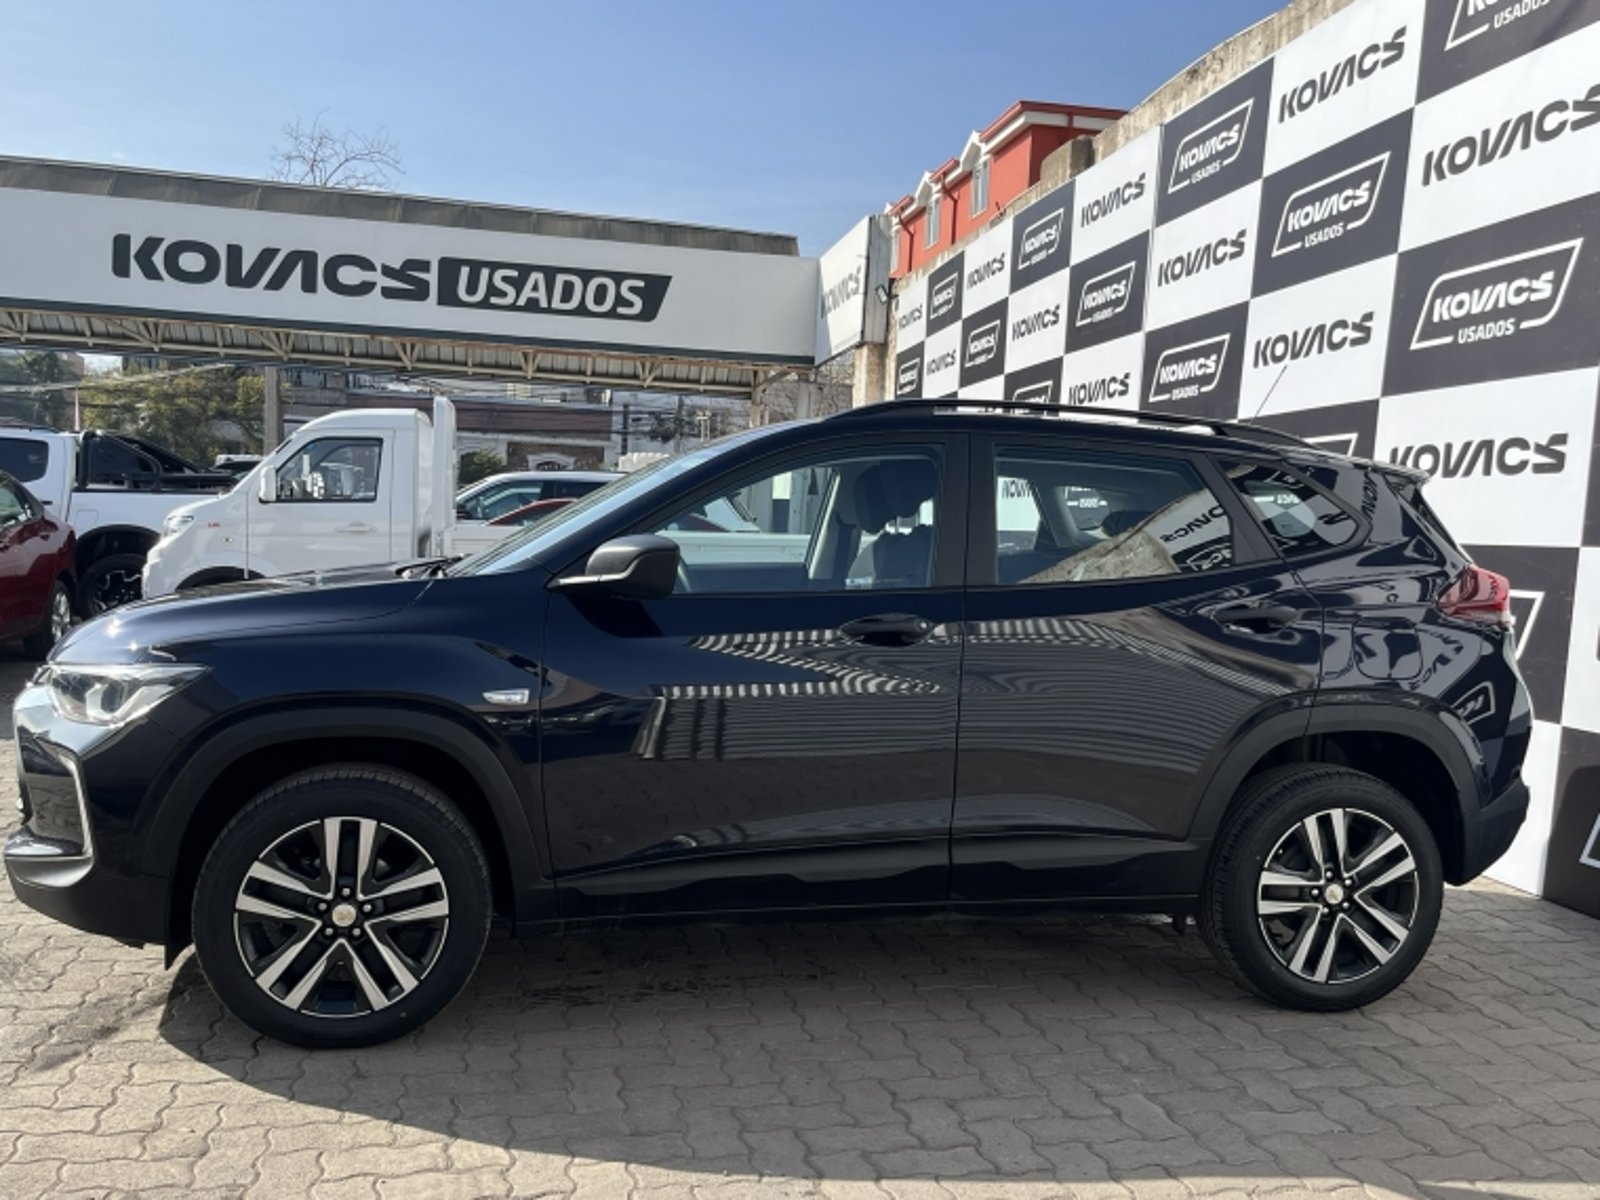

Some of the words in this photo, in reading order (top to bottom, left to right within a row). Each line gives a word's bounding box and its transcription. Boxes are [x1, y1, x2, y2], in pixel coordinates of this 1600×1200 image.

[1493, 0, 1550, 29] USADO
[1278, 25, 1407, 124] KOVACS
[1178, 123, 1241, 173] KOVACS
[1422, 84, 1600, 187] KOVACS
[1190, 159, 1222, 183] USADOS
[1081, 172, 1146, 228] KOVACS
[1287, 180, 1371, 233] KOVACS
[1157, 228, 1247, 287] KOVACS
[1304, 222, 1344, 248] USADOS
[111, 233, 431, 302] KOVACS
[455, 265, 645, 315] USADOS
[1084, 280, 1127, 310] KOVACS
[1432, 270, 1554, 322] KOVACS
[1012, 304, 1060, 340] KOVACS
[1252, 311, 1374, 369] KOVACS
[1457, 318, 1516, 344] USADOS
[1068, 372, 1131, 406] KOVACS
[1159, 354, 1218, 385] KOVACS
